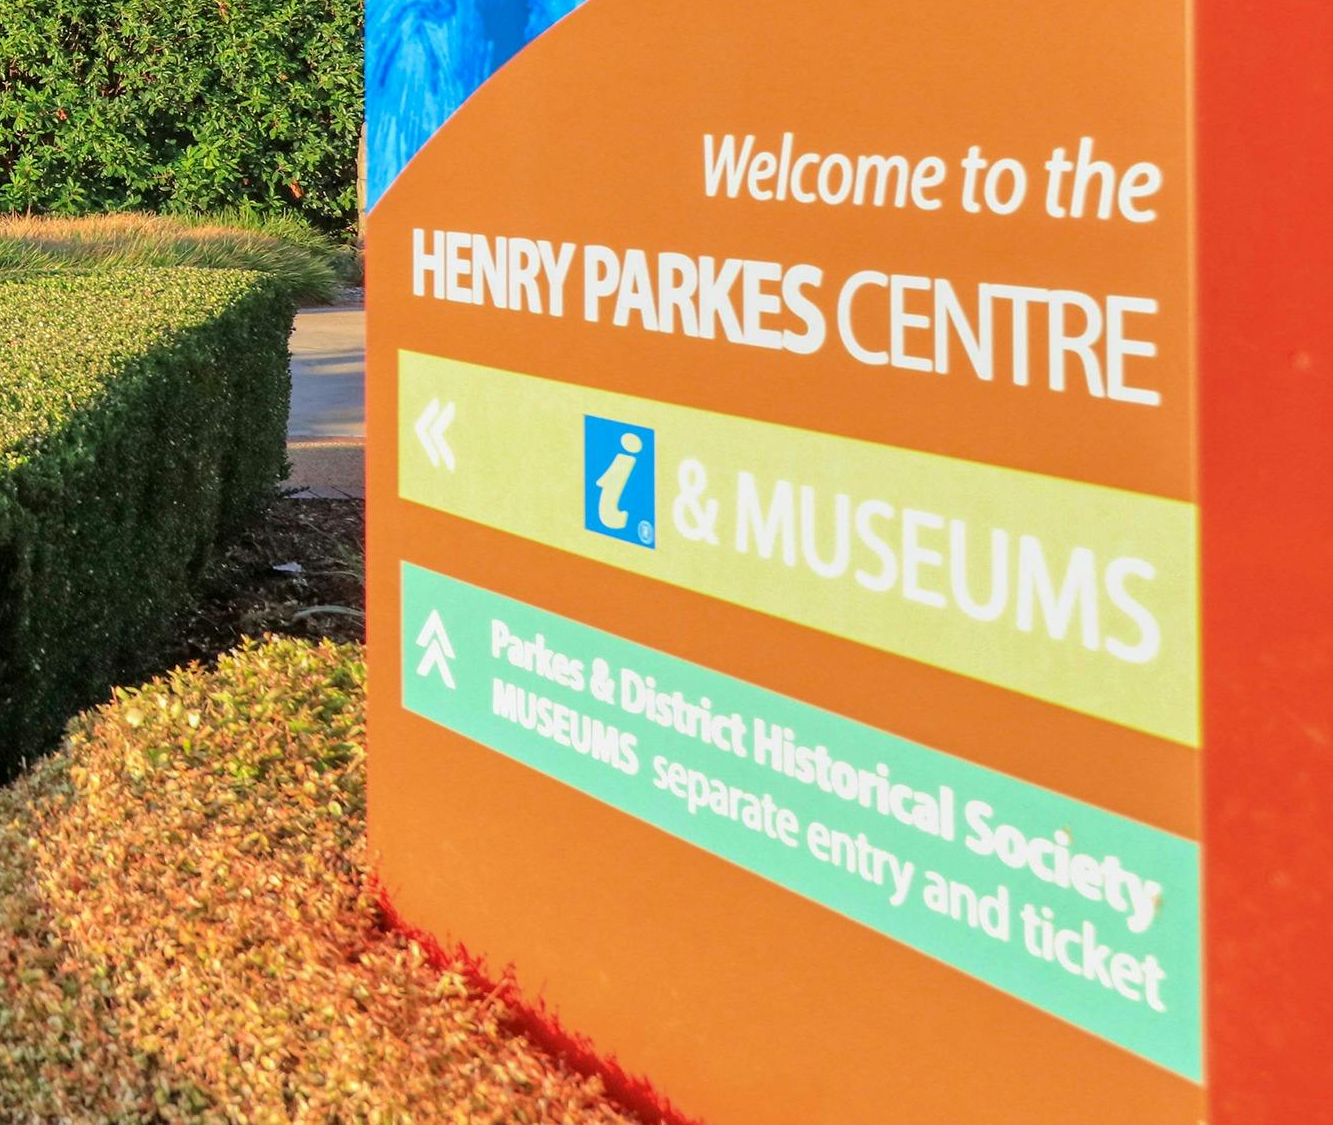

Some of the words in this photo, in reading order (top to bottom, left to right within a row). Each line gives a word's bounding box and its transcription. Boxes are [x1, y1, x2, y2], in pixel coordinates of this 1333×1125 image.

[703, 133, 945, 209] Welcome
[960, 144, 1026, 217] to
[1044, 137, 1160, 222] the
[413, 228, 574, 317] HENRY
[583, 244, 825, 355] PARKES
[837, 270, 1160, 406] CENTRE
[674, 458, 719, 537] &
[736, 481, 1160, 665] MUSEUMS
[491, 619, 583, 694] Parkes
[591, 657, 614, 705] &
[622, 667, 745, 755] District
[755, 717, 955, 841] Historical
[966, 800, 1160, 933] Society
[491, 683, 638, 775] MUSEUMS
[653, 751, 797, 847] separate
[808, 819, 913, 905] entry
[924, 869, 1008, 941] and
[1021, 902, 1166, 1011] ticket
